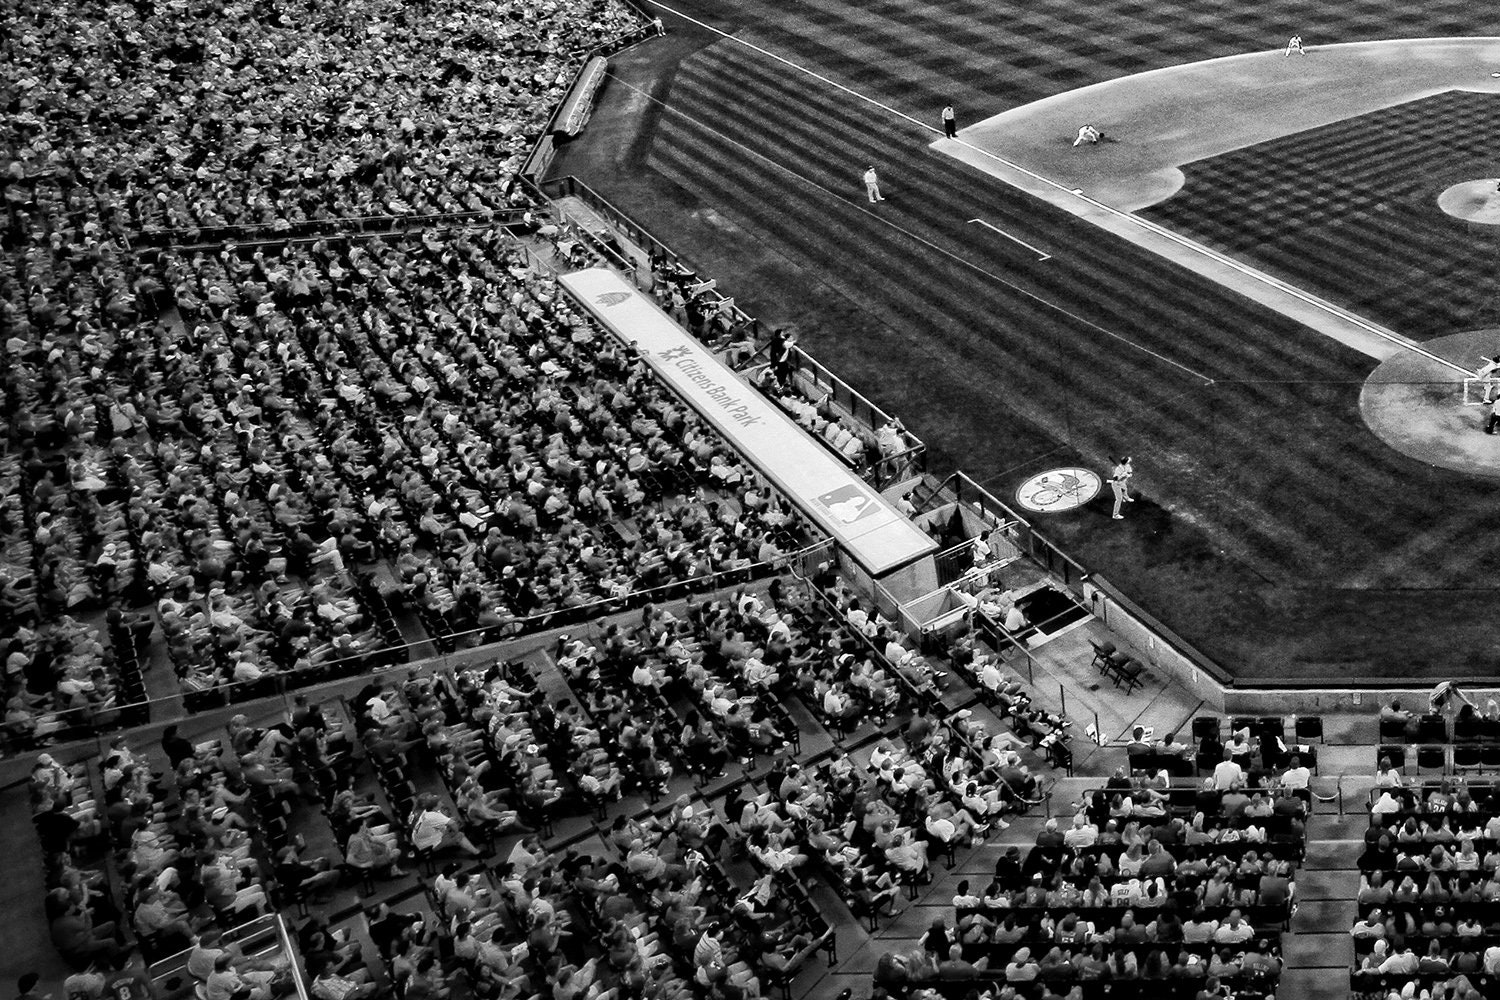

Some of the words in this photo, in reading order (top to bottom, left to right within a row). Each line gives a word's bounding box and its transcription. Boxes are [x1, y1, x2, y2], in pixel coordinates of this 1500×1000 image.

[675, 357, 713, 396] Citizens
[706, 386, 737, 416] Bank
[727, 400, 759, 430] Park
[119, 986, 132, 1000] 8
